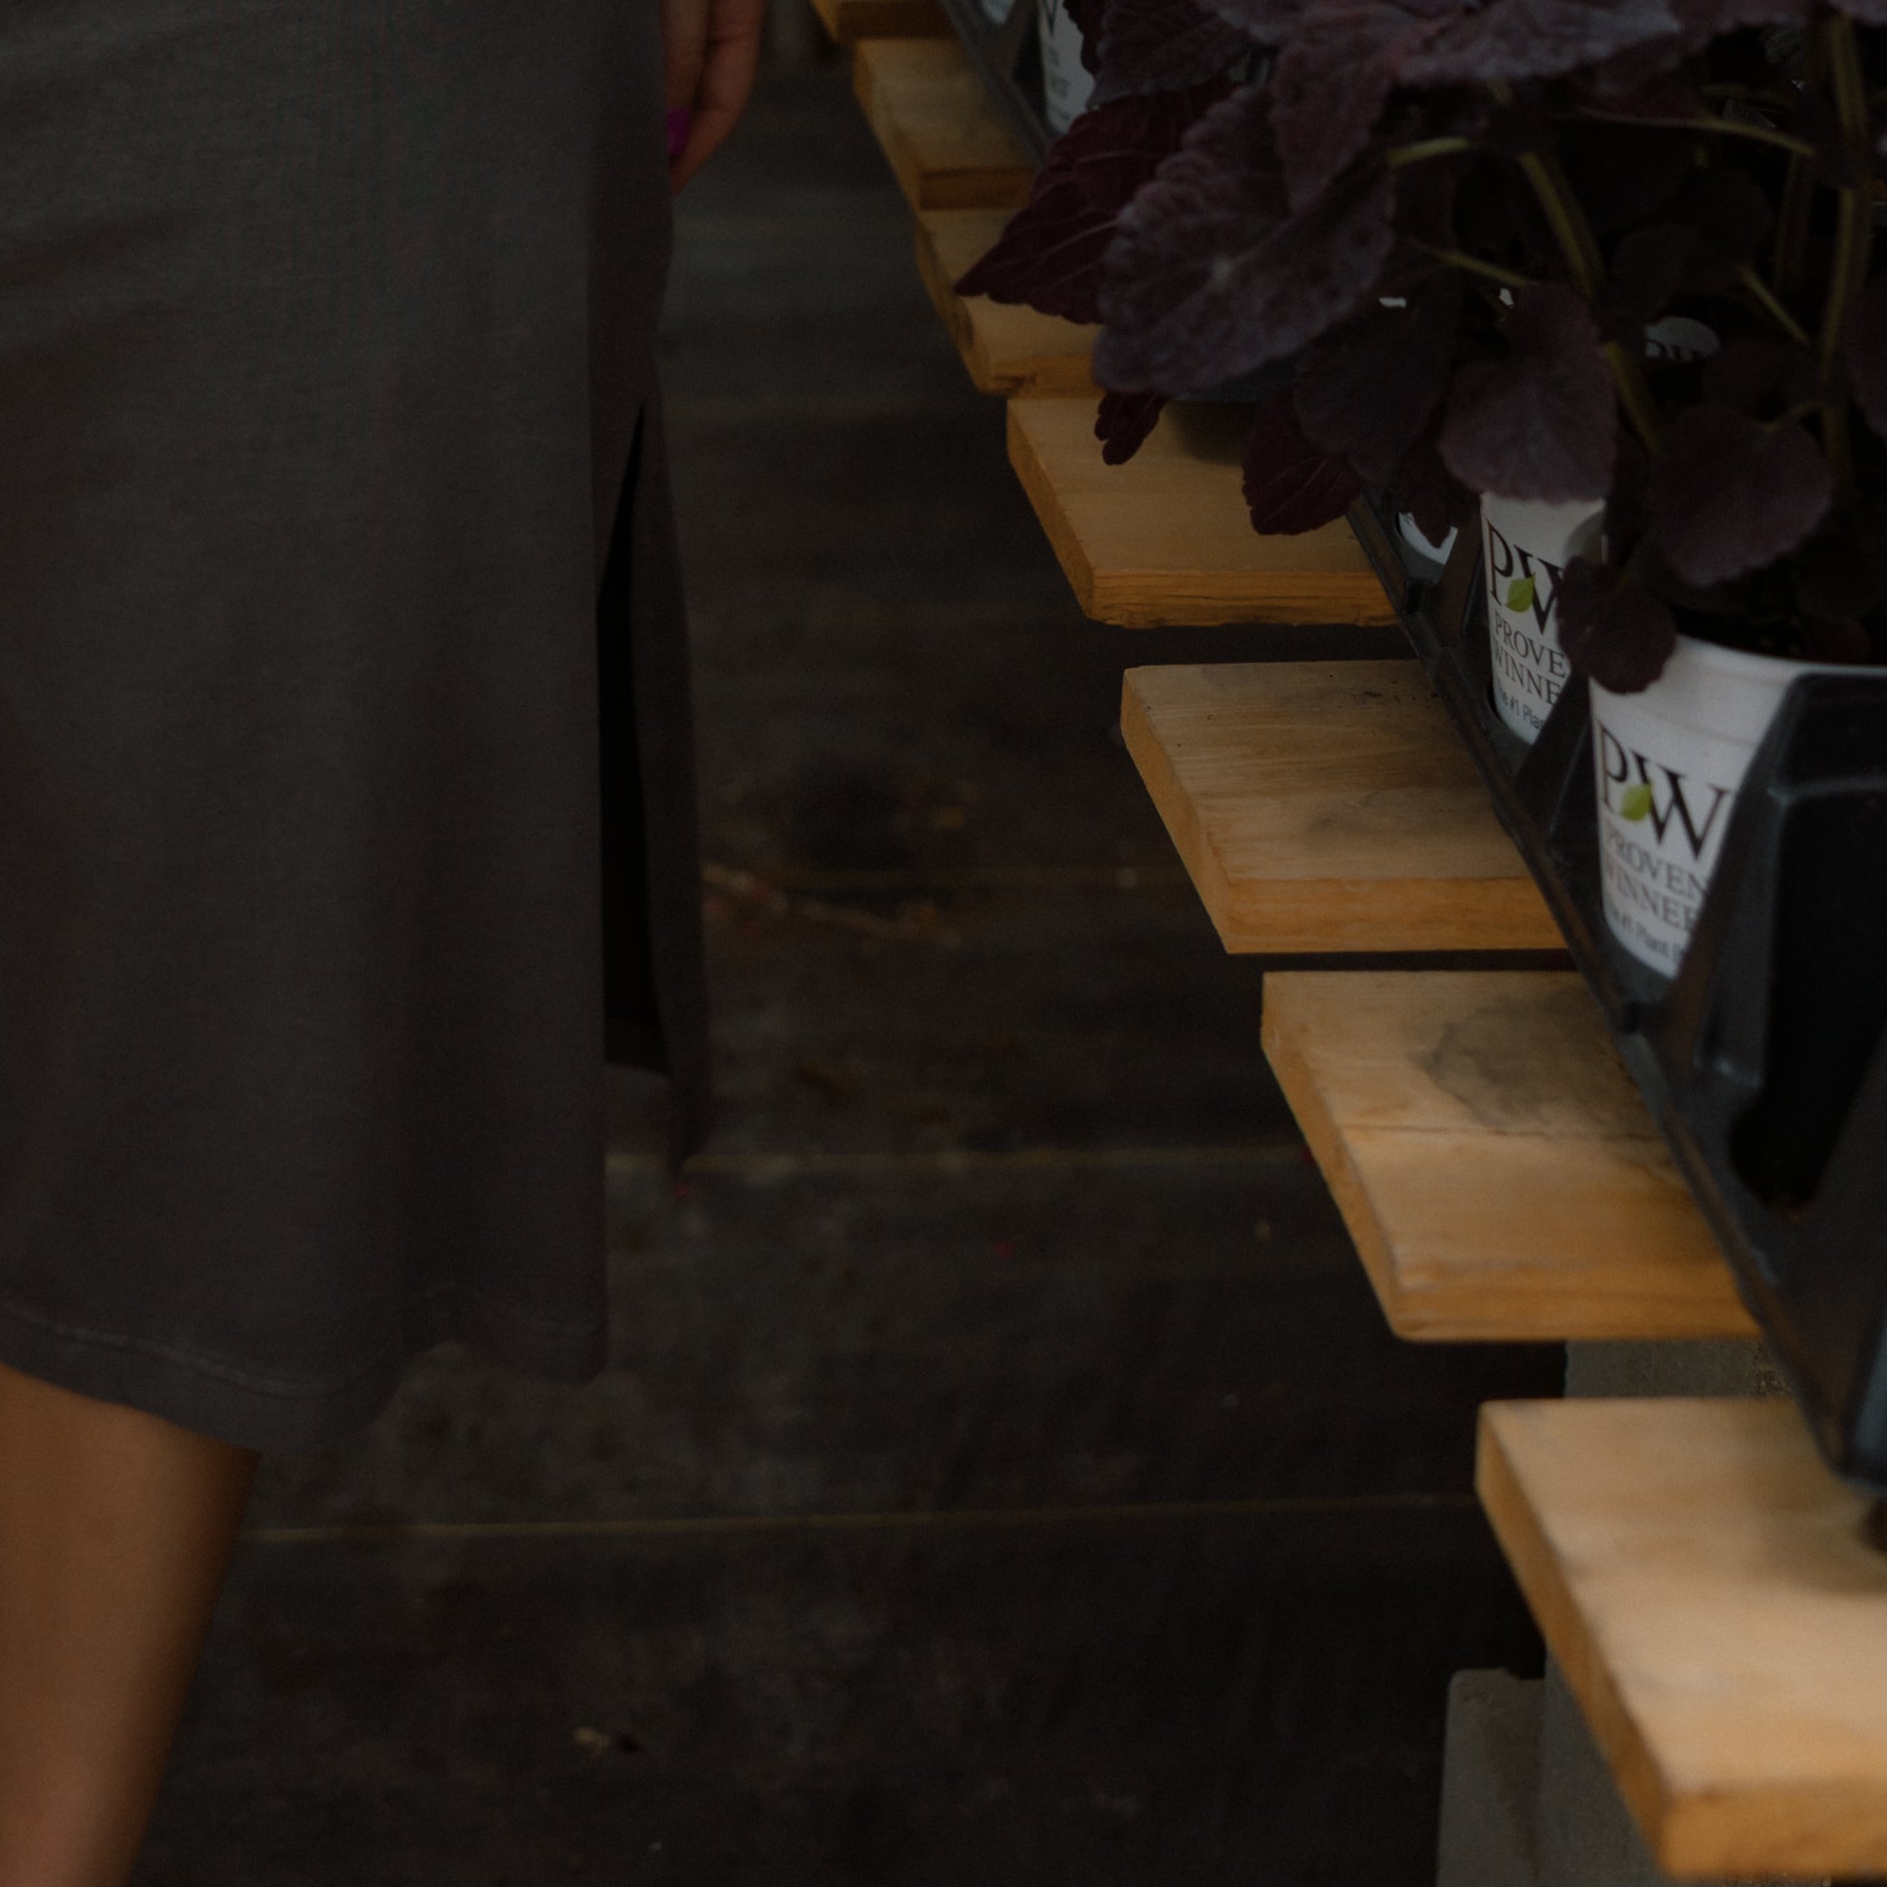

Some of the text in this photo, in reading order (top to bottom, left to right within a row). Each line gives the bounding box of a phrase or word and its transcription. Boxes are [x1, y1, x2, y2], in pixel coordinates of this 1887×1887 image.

[1492, 635, 1561, 706] WINNE
[1495, 612, 1566, 678] PROVE
[1599, 720, 1732, 860] PW
